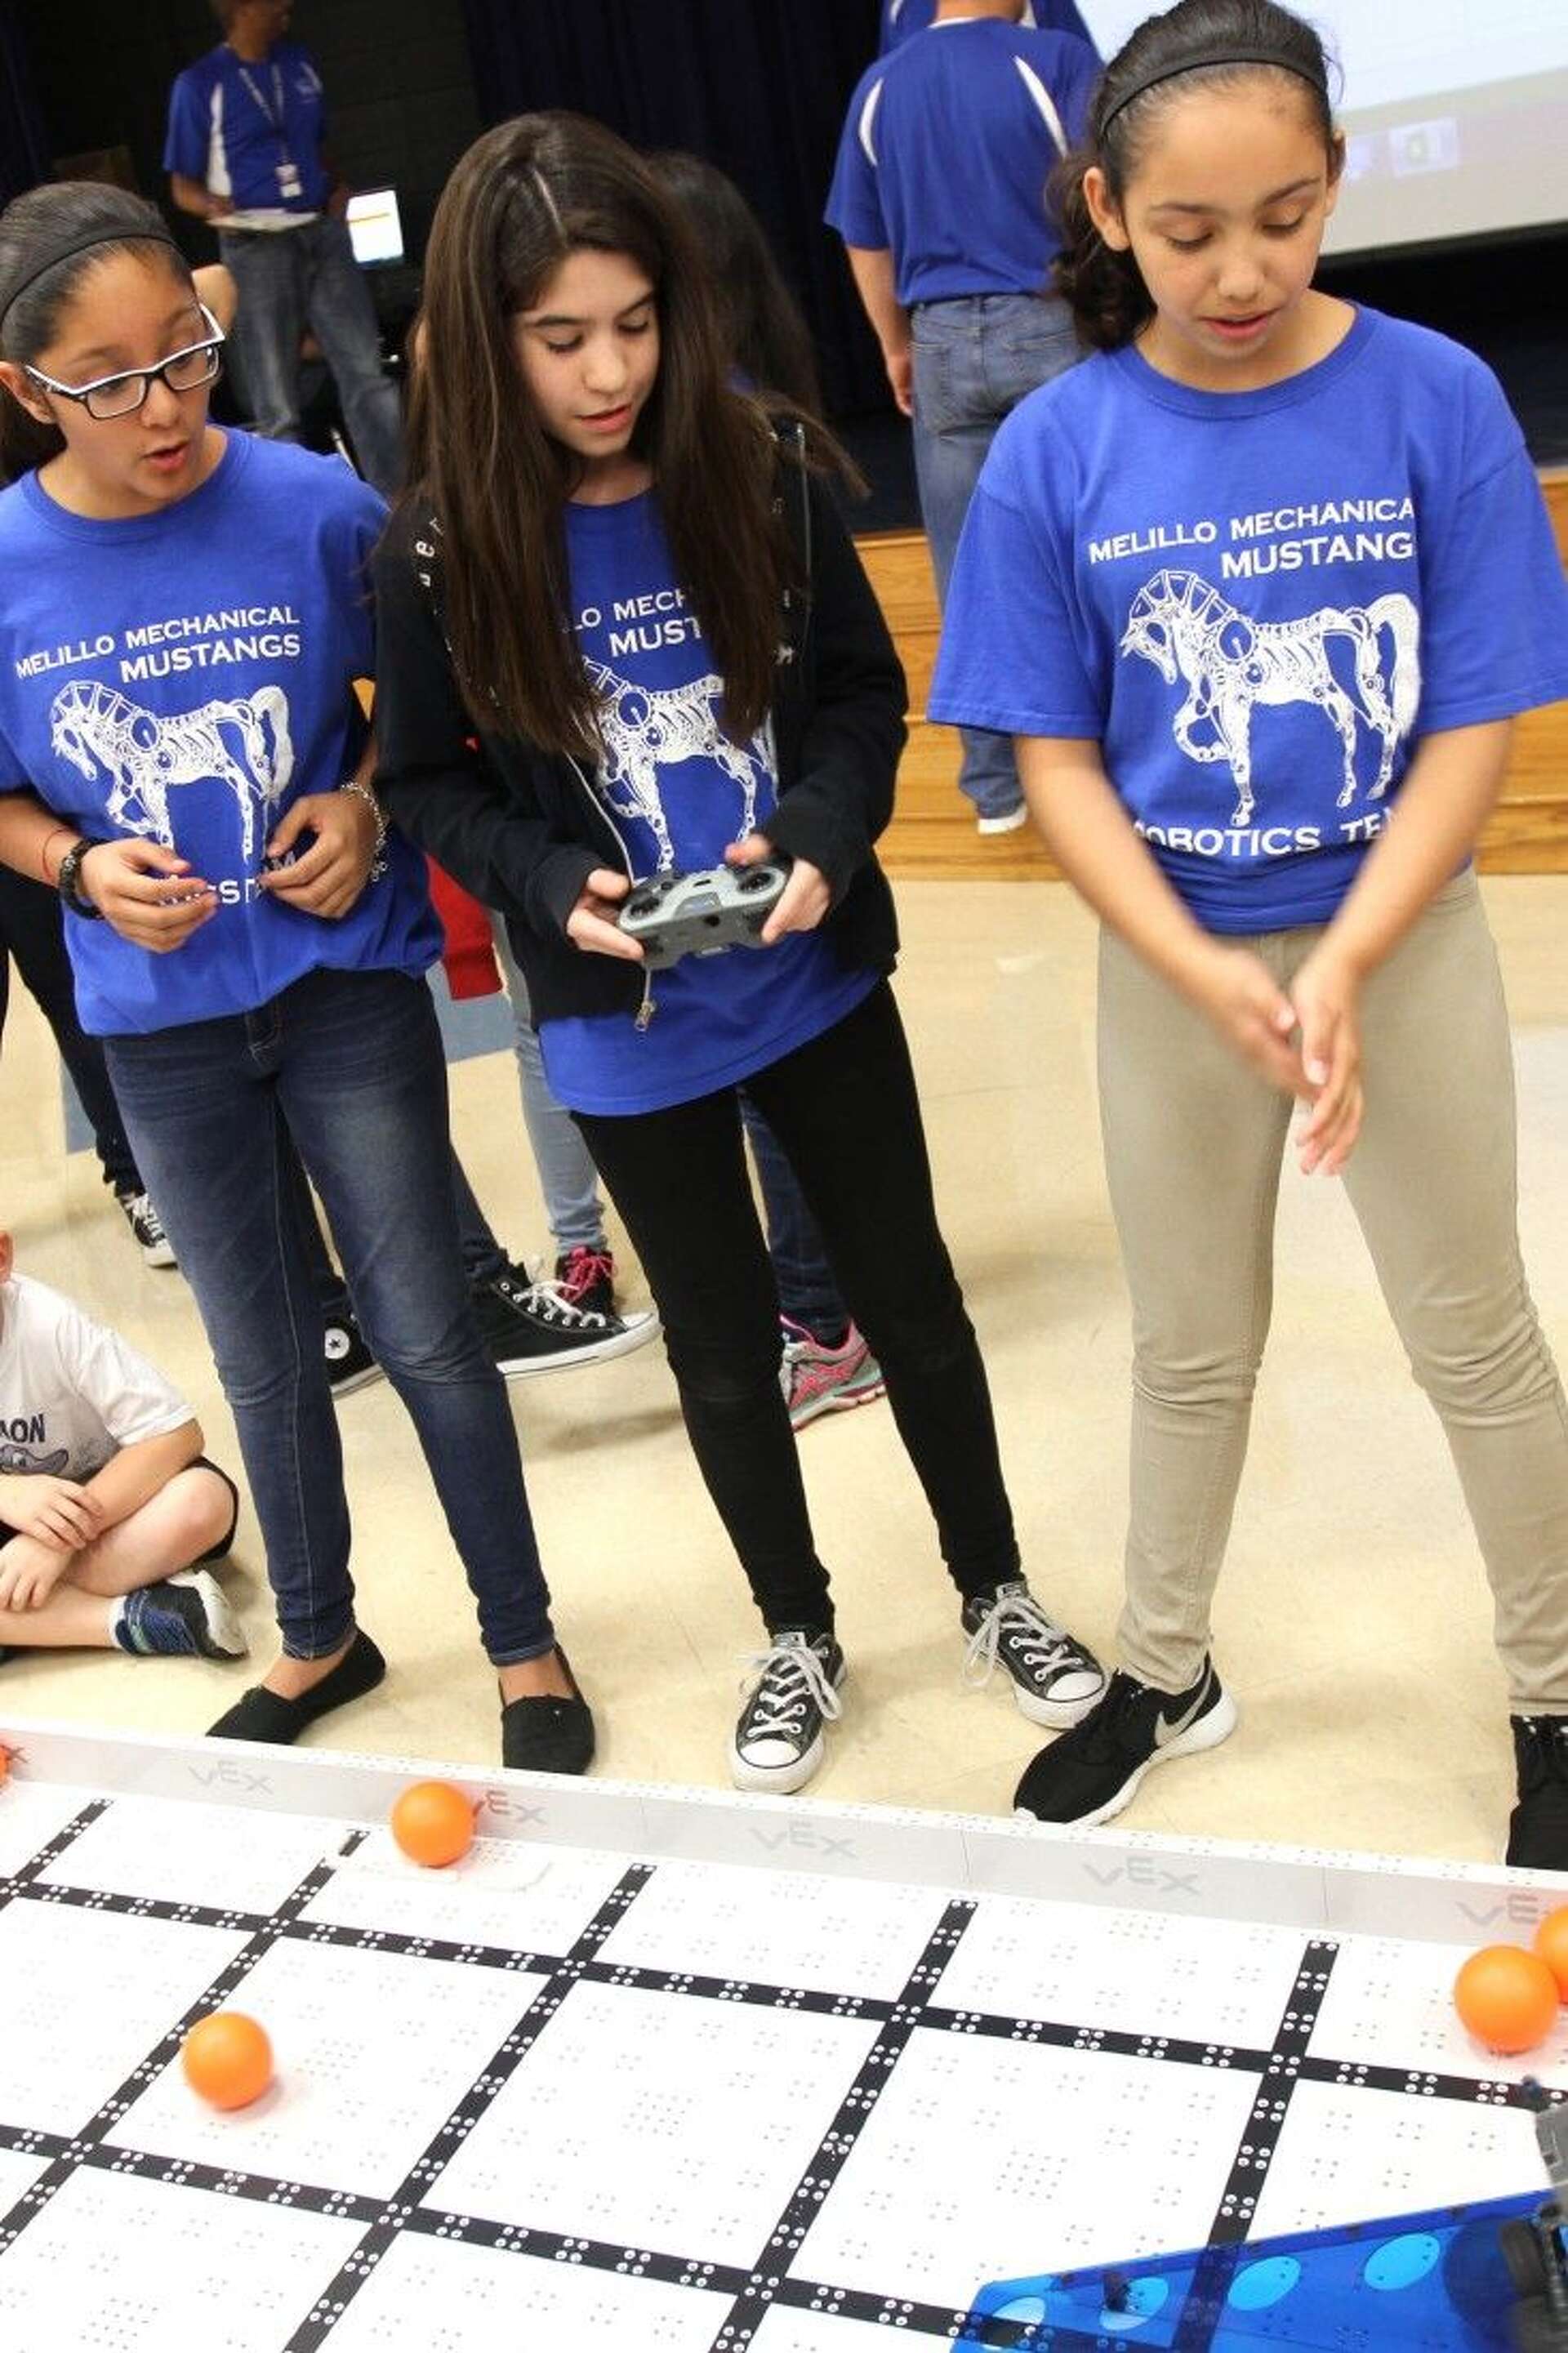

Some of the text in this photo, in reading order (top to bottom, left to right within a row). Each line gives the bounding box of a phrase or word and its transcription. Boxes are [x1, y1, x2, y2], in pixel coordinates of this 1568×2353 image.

[1088, 520, 1218, 565] MELILLO
[1221, 531, 1414, 580] MUSTANG
[15, 605, 301, 680] MELILLO MECHANICAL
[119, 634, 301, 684] MUSTANGS
[187, 1759, 275, 1796] VEX
[746, 1820, 859, 1860] VEX
[1081, 1856, 1201, 1896] VEX
[1454, 1893, 1547, 1926] VE
